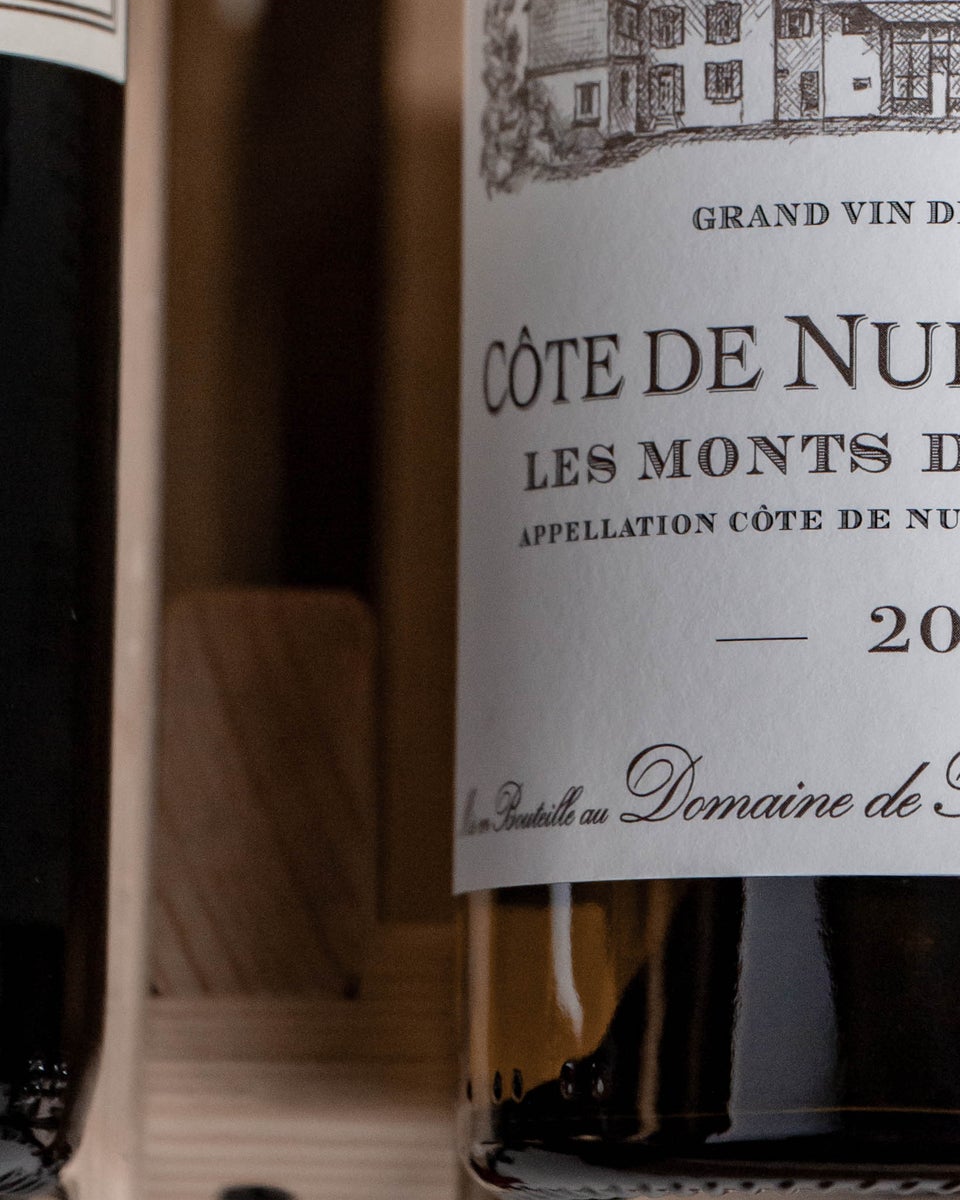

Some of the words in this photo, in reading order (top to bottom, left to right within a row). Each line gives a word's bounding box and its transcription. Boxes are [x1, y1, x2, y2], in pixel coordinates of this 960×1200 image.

[692, 202, 831, 232] GRAND
[841, 201, 916, 225] VIN
[482, 324, 625, 416] CÔTE
[642, 324, 765, 397] DE
[523, 443, 617, 491] LES
[637, 432, 893, 481] MONTS
[519, 512, 719, 548] APPELLATION
[728, 504, 822, 533] CÔTE
[837, 508, 891, 530] DE
[579, 807, 609, 826] au
[619, 743, 855, 824] Domaine
[864, 761, 922, 819] de
